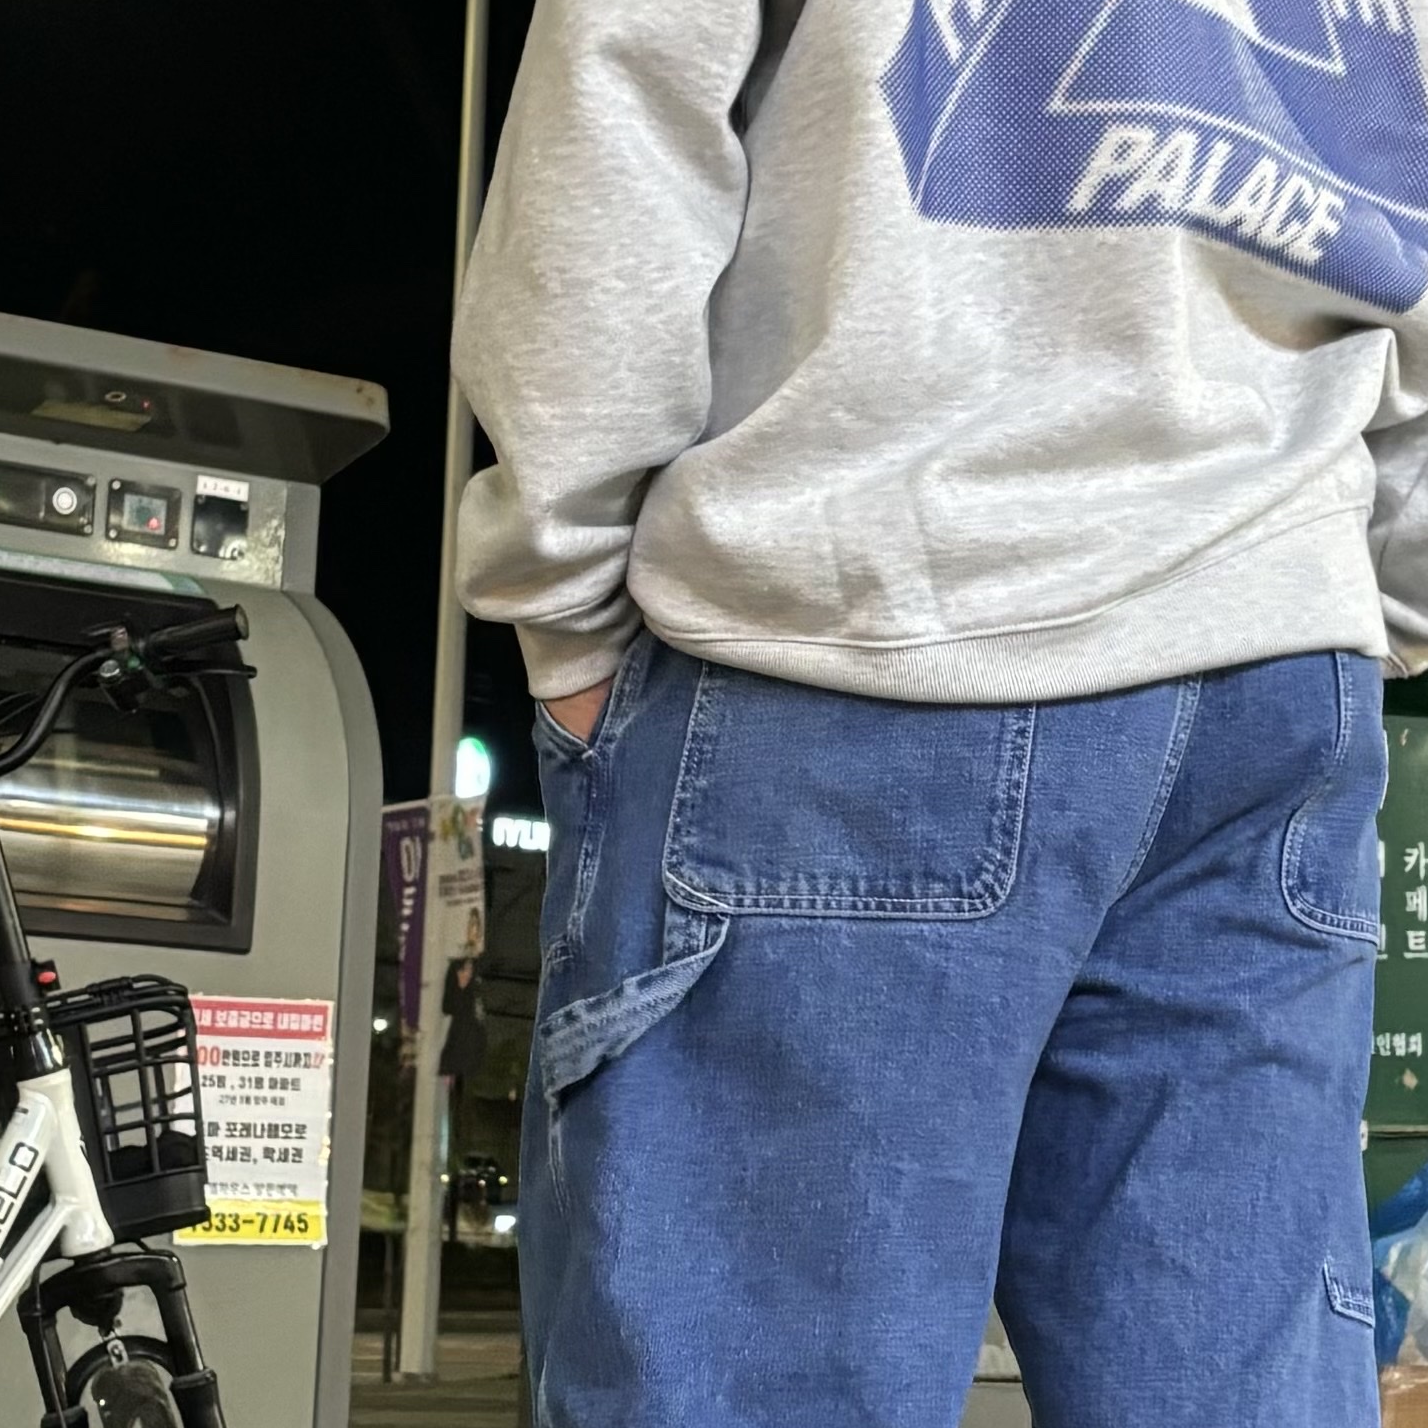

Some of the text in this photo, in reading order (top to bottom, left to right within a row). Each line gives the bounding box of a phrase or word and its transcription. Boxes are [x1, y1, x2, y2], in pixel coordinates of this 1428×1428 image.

[1066, 124, 1346, 263] PALACE
[196, 1046, 260, 1068] 00만원으로
[1371, 1032, 1422, 1057] 인협회
